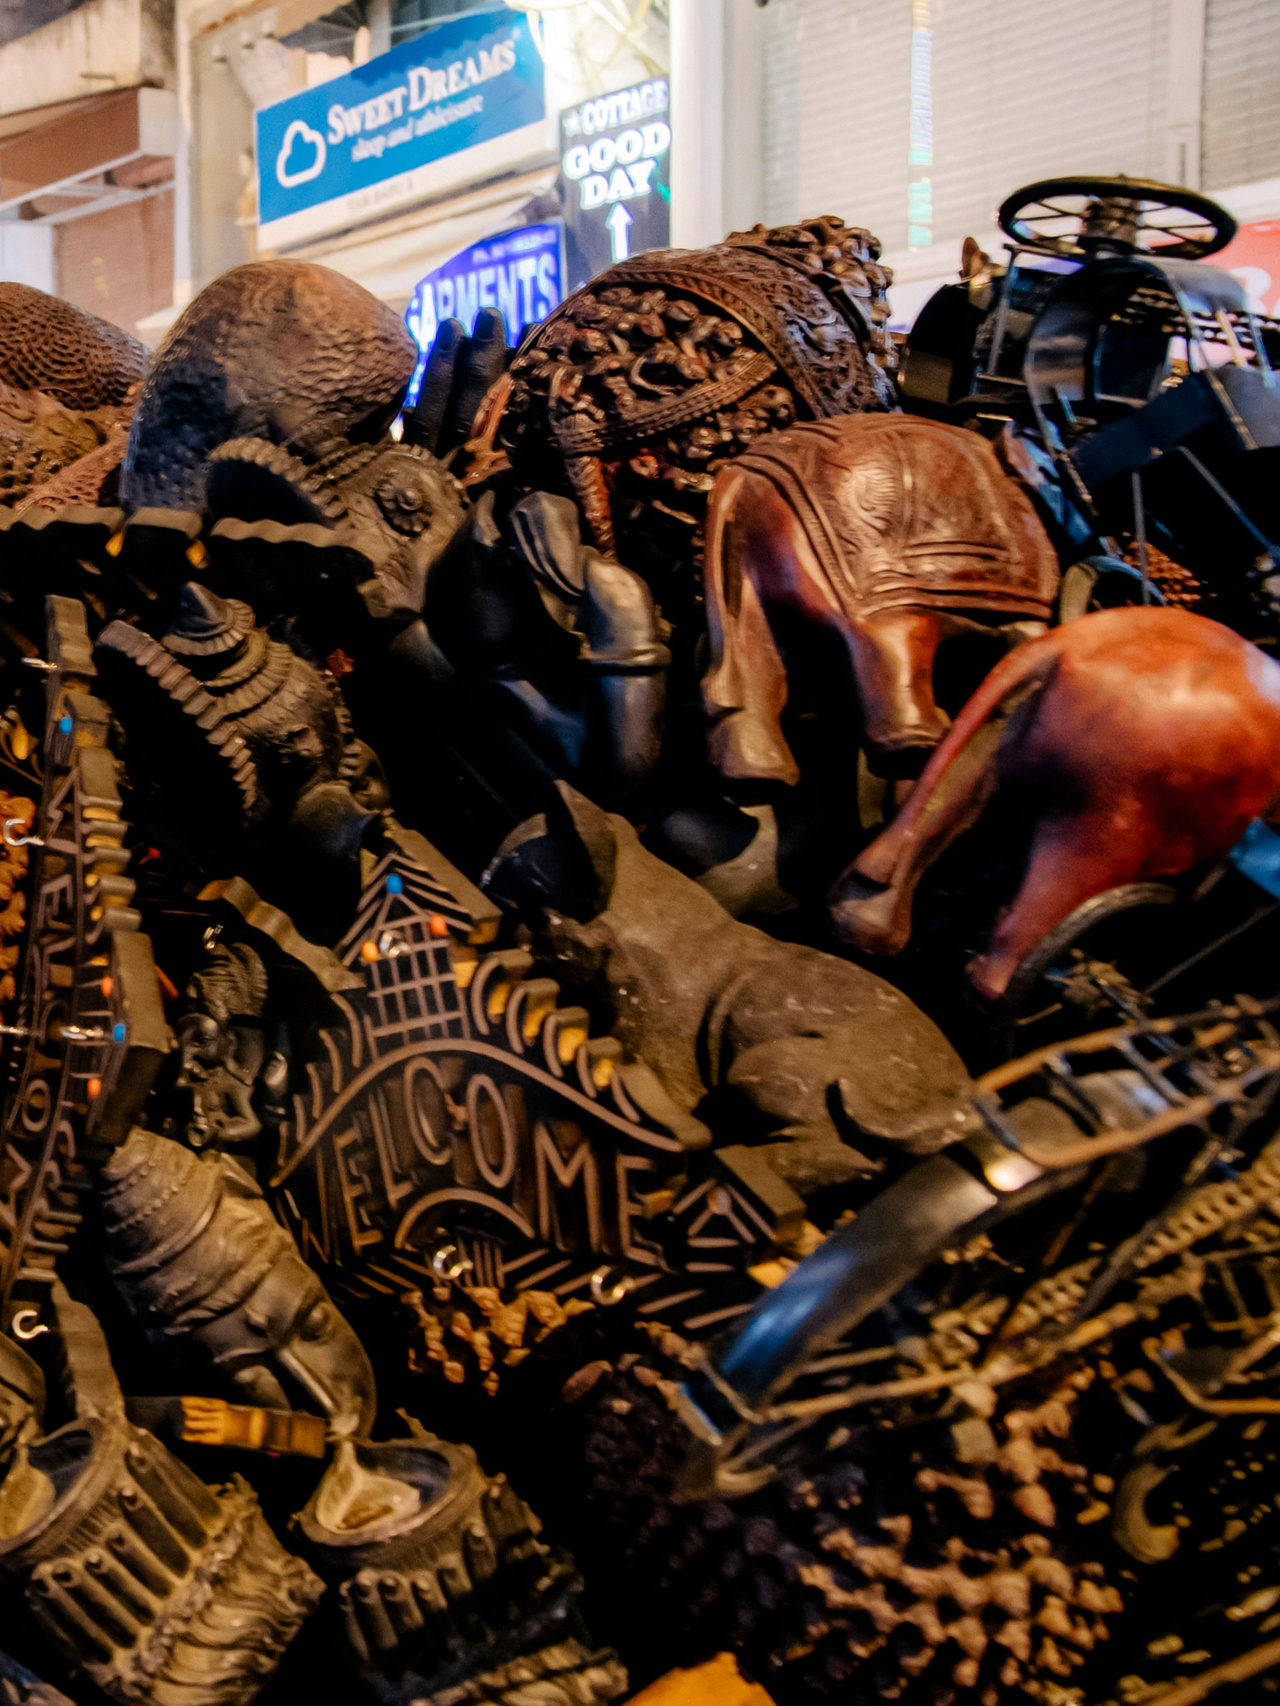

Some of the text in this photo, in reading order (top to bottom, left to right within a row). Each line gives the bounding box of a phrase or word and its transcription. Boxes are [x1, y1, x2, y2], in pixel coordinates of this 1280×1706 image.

[407, 40, 517, 112] DREAMS
[580, 79, 669, 135] COTTAGE
[562, 121, 672, 180] GOOD
[579, 158, 658, 210] DAY
